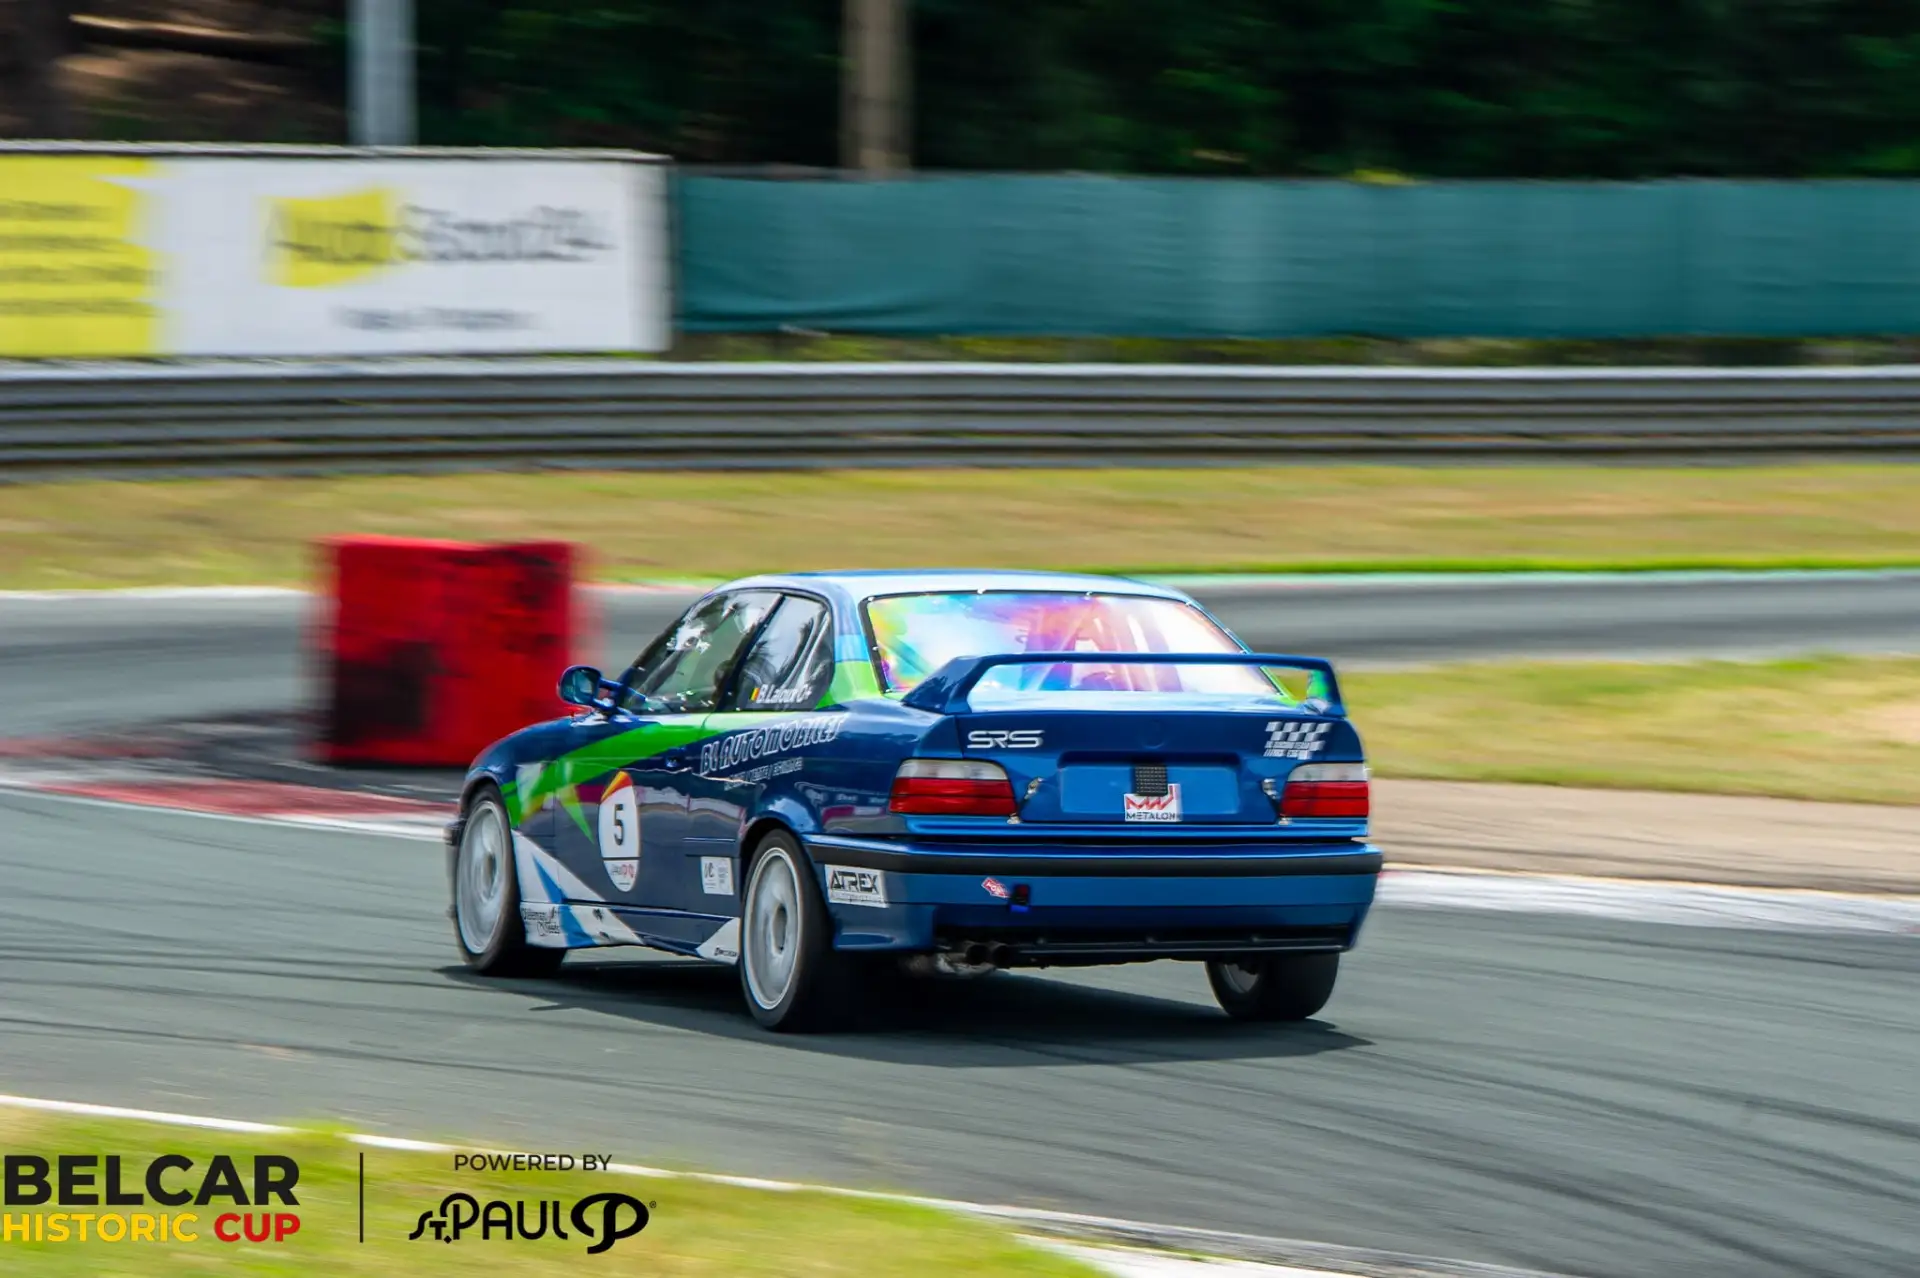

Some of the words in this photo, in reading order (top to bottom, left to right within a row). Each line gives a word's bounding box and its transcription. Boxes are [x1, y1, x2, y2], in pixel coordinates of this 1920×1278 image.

[719, 714, 847, 769] AUTOMOBILES
[966, 730, 1045, 748] SRS
[613, 803, 625, 846] 5
[830, 870, 880, 894] ATREX
